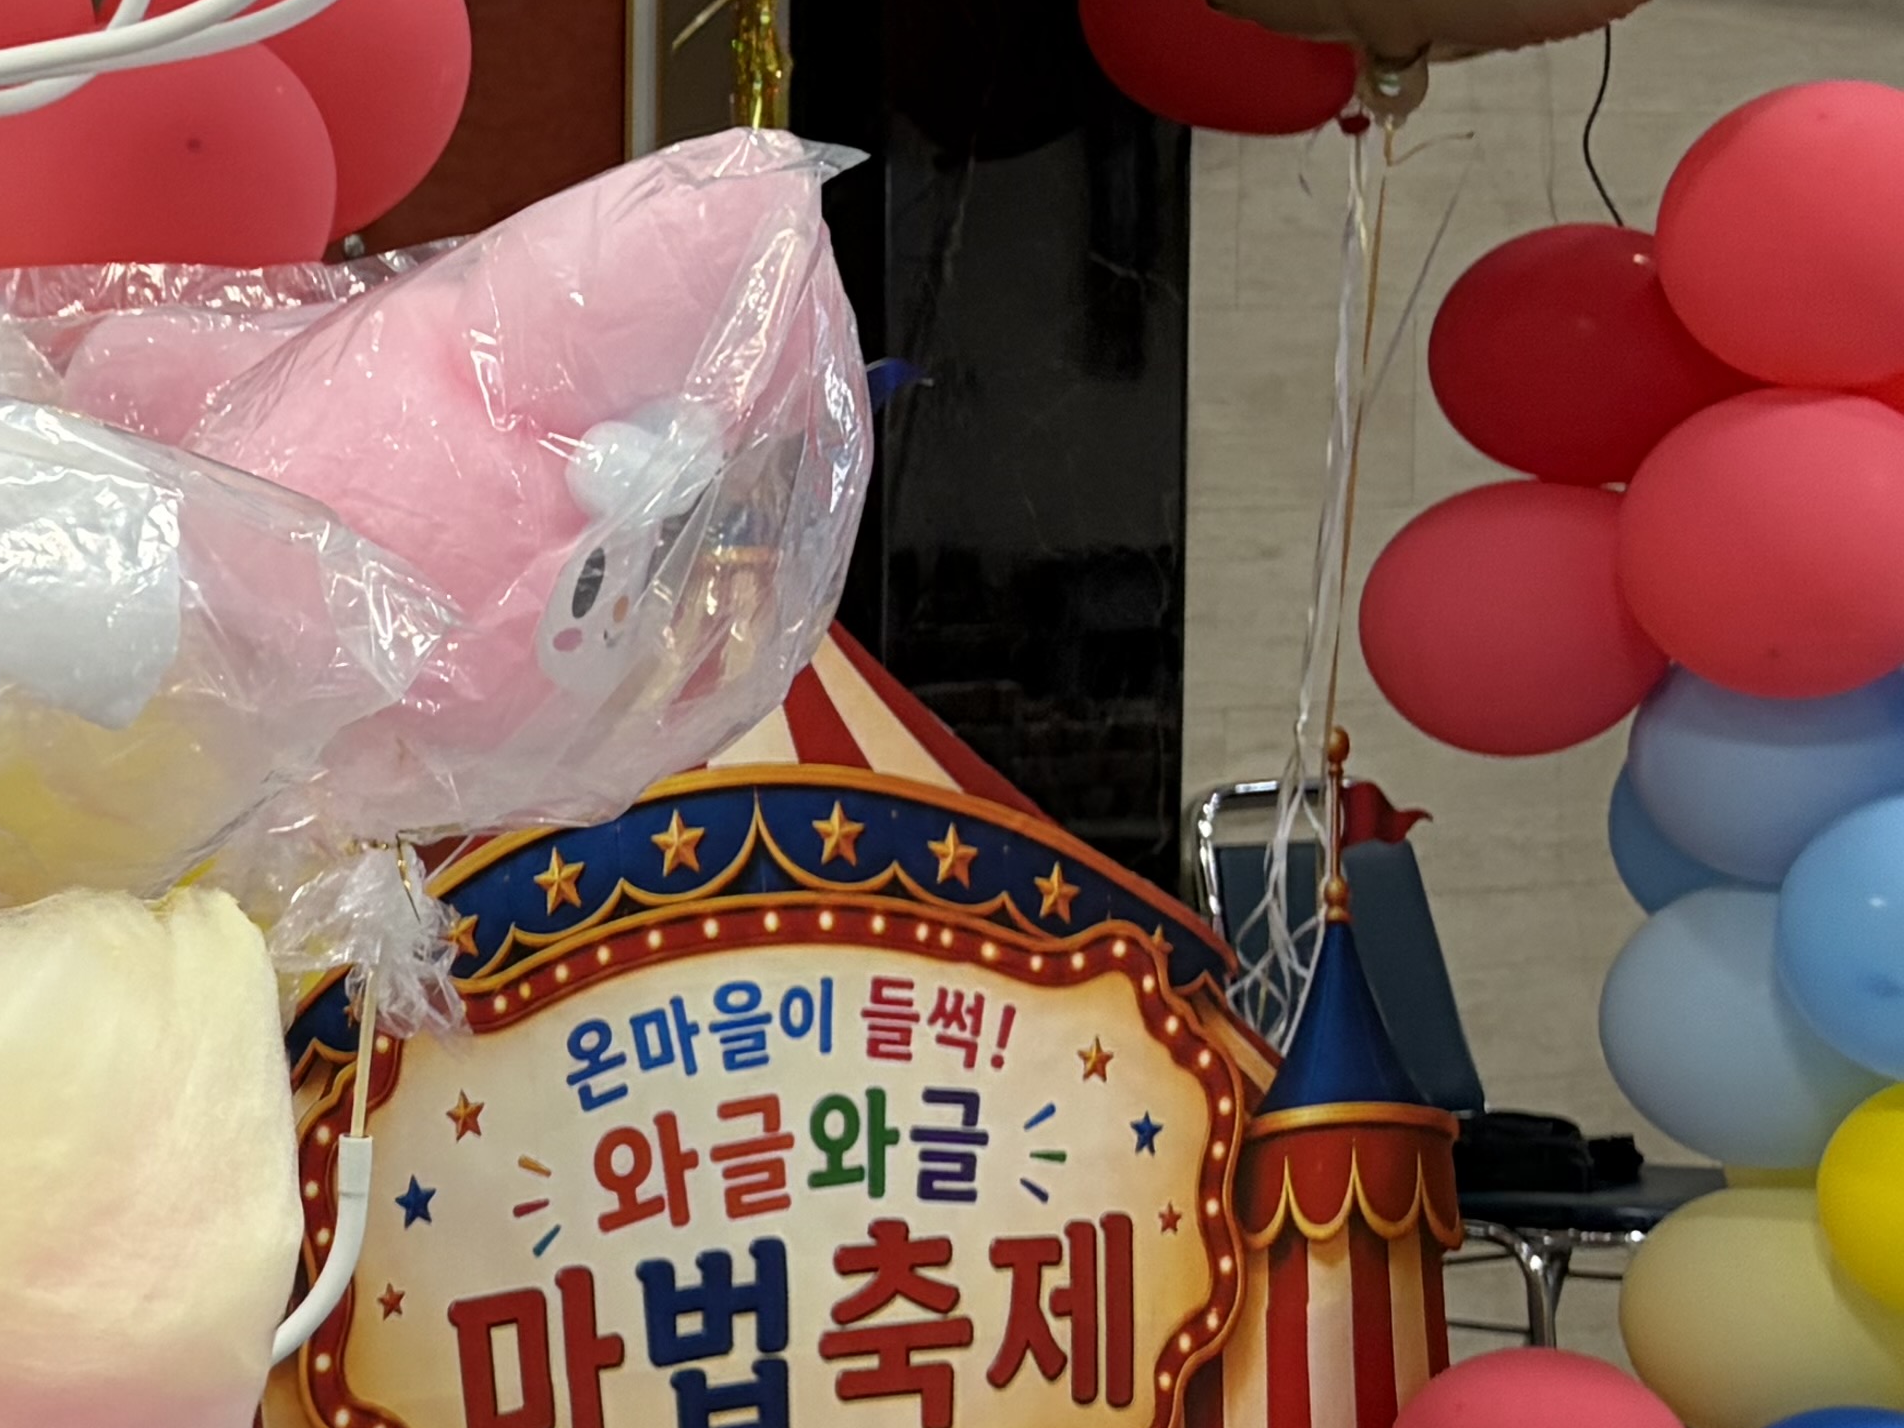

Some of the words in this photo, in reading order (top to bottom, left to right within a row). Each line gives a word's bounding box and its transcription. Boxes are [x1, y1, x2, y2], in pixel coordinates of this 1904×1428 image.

[566, 975, 836, 1110] 온마을이
[860, 976, 1016, 1070] 들썩!
[593, 1085, 991, 1232] 와글와글
